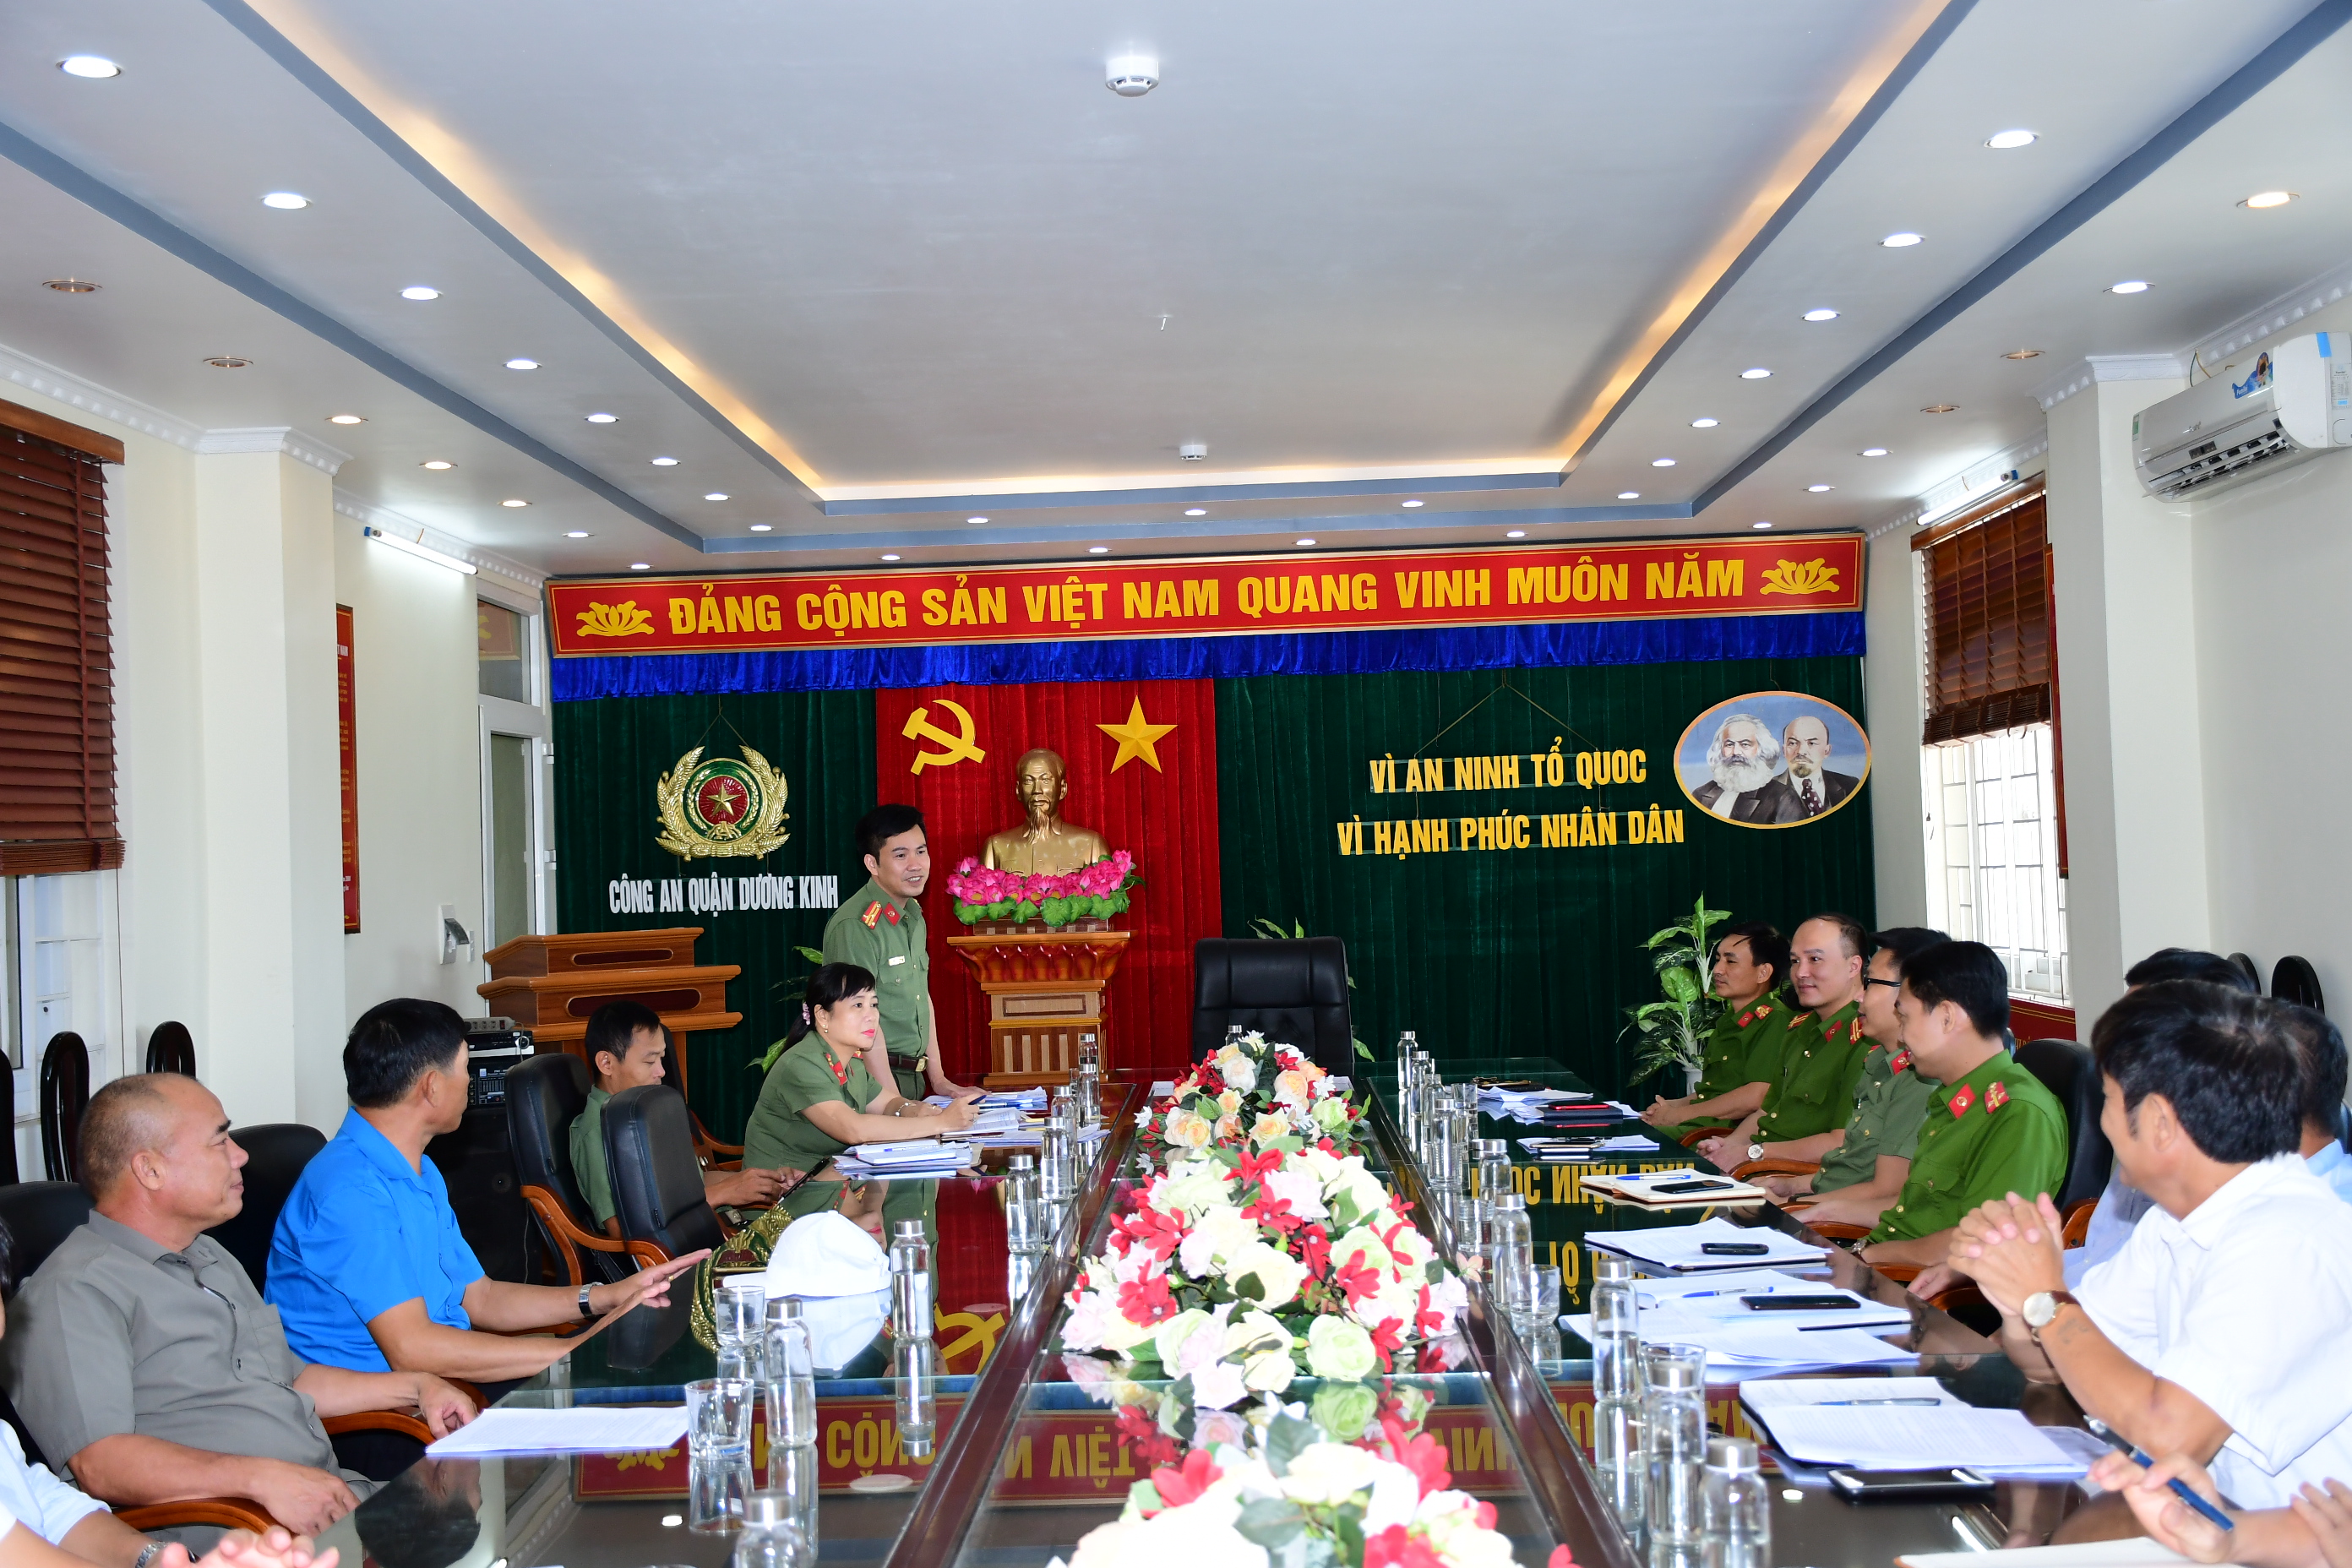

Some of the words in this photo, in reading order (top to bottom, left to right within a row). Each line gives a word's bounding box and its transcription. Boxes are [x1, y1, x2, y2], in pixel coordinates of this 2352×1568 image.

[669, 583, 781, 634] ĐẢNG
[797, 585, 906, 636] CỘNG
[922, 574, 1007, 625] SẢN
[1023, 576, 1108, 629] VIỆT
[1123, 580, 1219, 619] NAM
[1238, 573, 1378, 618] QUANG
[1395, 569, 1491, 608] VINH
[1508, 556, 1629, 604] MUÔN
[1647, 552, 1745, 599] NĂM
[1369, 753, 1396, 793] VÌ
[1405, 758, 1445, 792] AN
[1454, 755, 1520, 791] NINH
[1531, 736, 1565, 787] TỔ
[1337, 814, 1363, 856] VÌ
[1374, 819, 1449, 860] HẠNH
[1460, 808, 1531, 851] PHÚC
[1541, 806, 1618, 848] NHÂN
[1628, 803, 1685, 845] DÂN
[608, 873, 655, 914] CÔNG
[659, 879, 684, 913] AN
[688, 871, 734, 917] QUẬN
[798, 874, 839, 909] KINH
